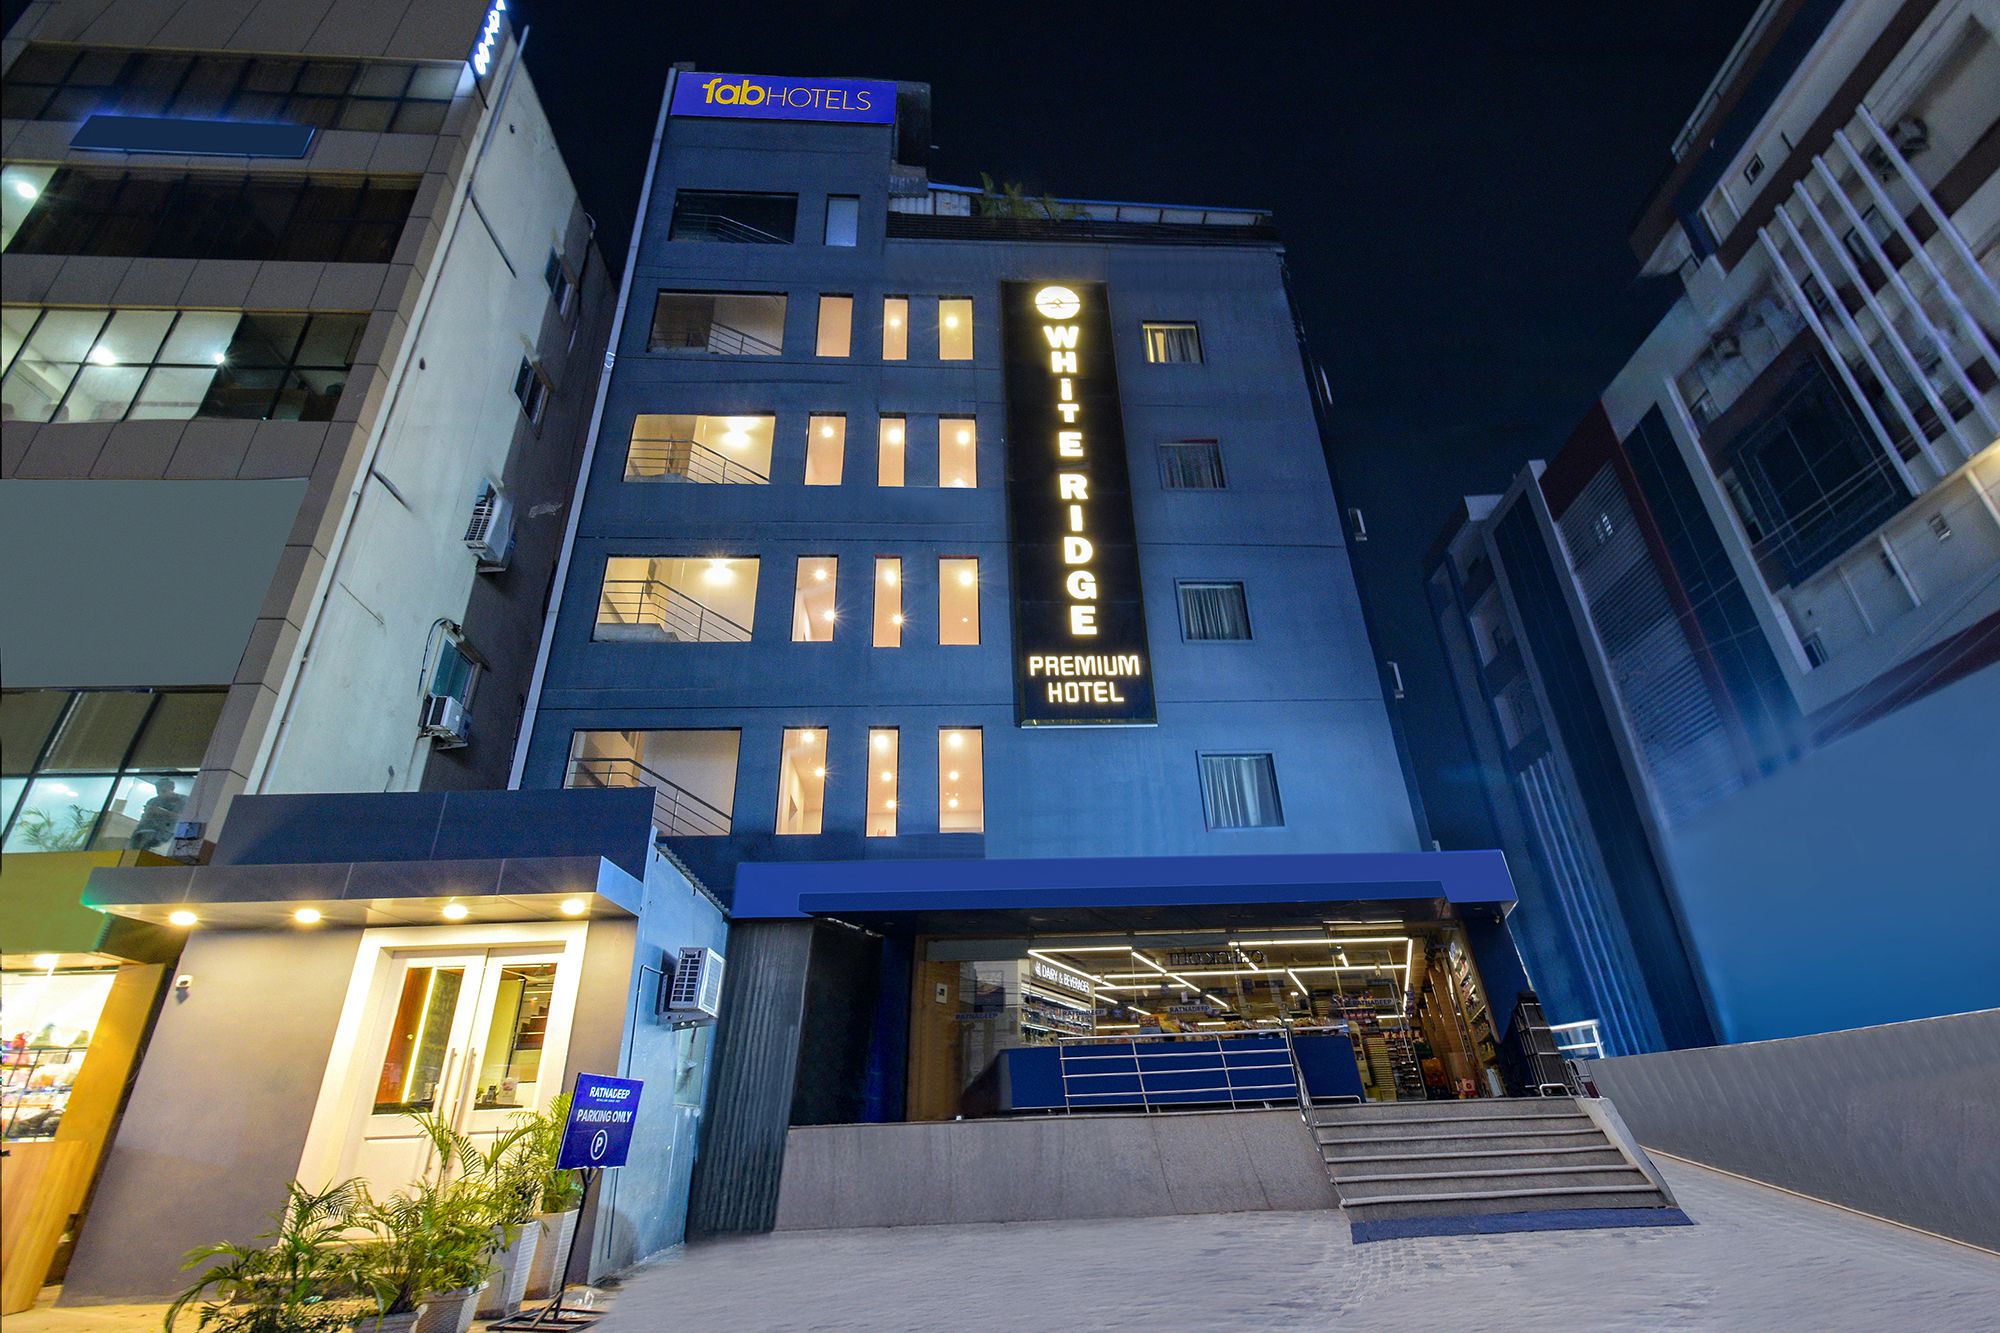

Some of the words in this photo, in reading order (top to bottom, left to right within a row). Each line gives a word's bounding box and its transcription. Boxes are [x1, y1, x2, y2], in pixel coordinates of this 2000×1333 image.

[1043, 326, 1083, 456] WHITE
[1059, 474, 1098, 634] RIDGE
[1029, 655, 1140, 676] PREMIUM
[1048, 681, 1124, 703] HOTEL
[1042, 964, 1058, 982] DAIRY
[1064, 973, 1090, 993] BEVERAGES
[1169, 1005, 1210, 1013] RATNADEEP
[589, 1086, 631, 1099] RATNADEEP
[576, 1109, 612, 1122] PARKING
[612, 1110, 632, 1123] ONLY
[594, 1137, 603, 1153] P
